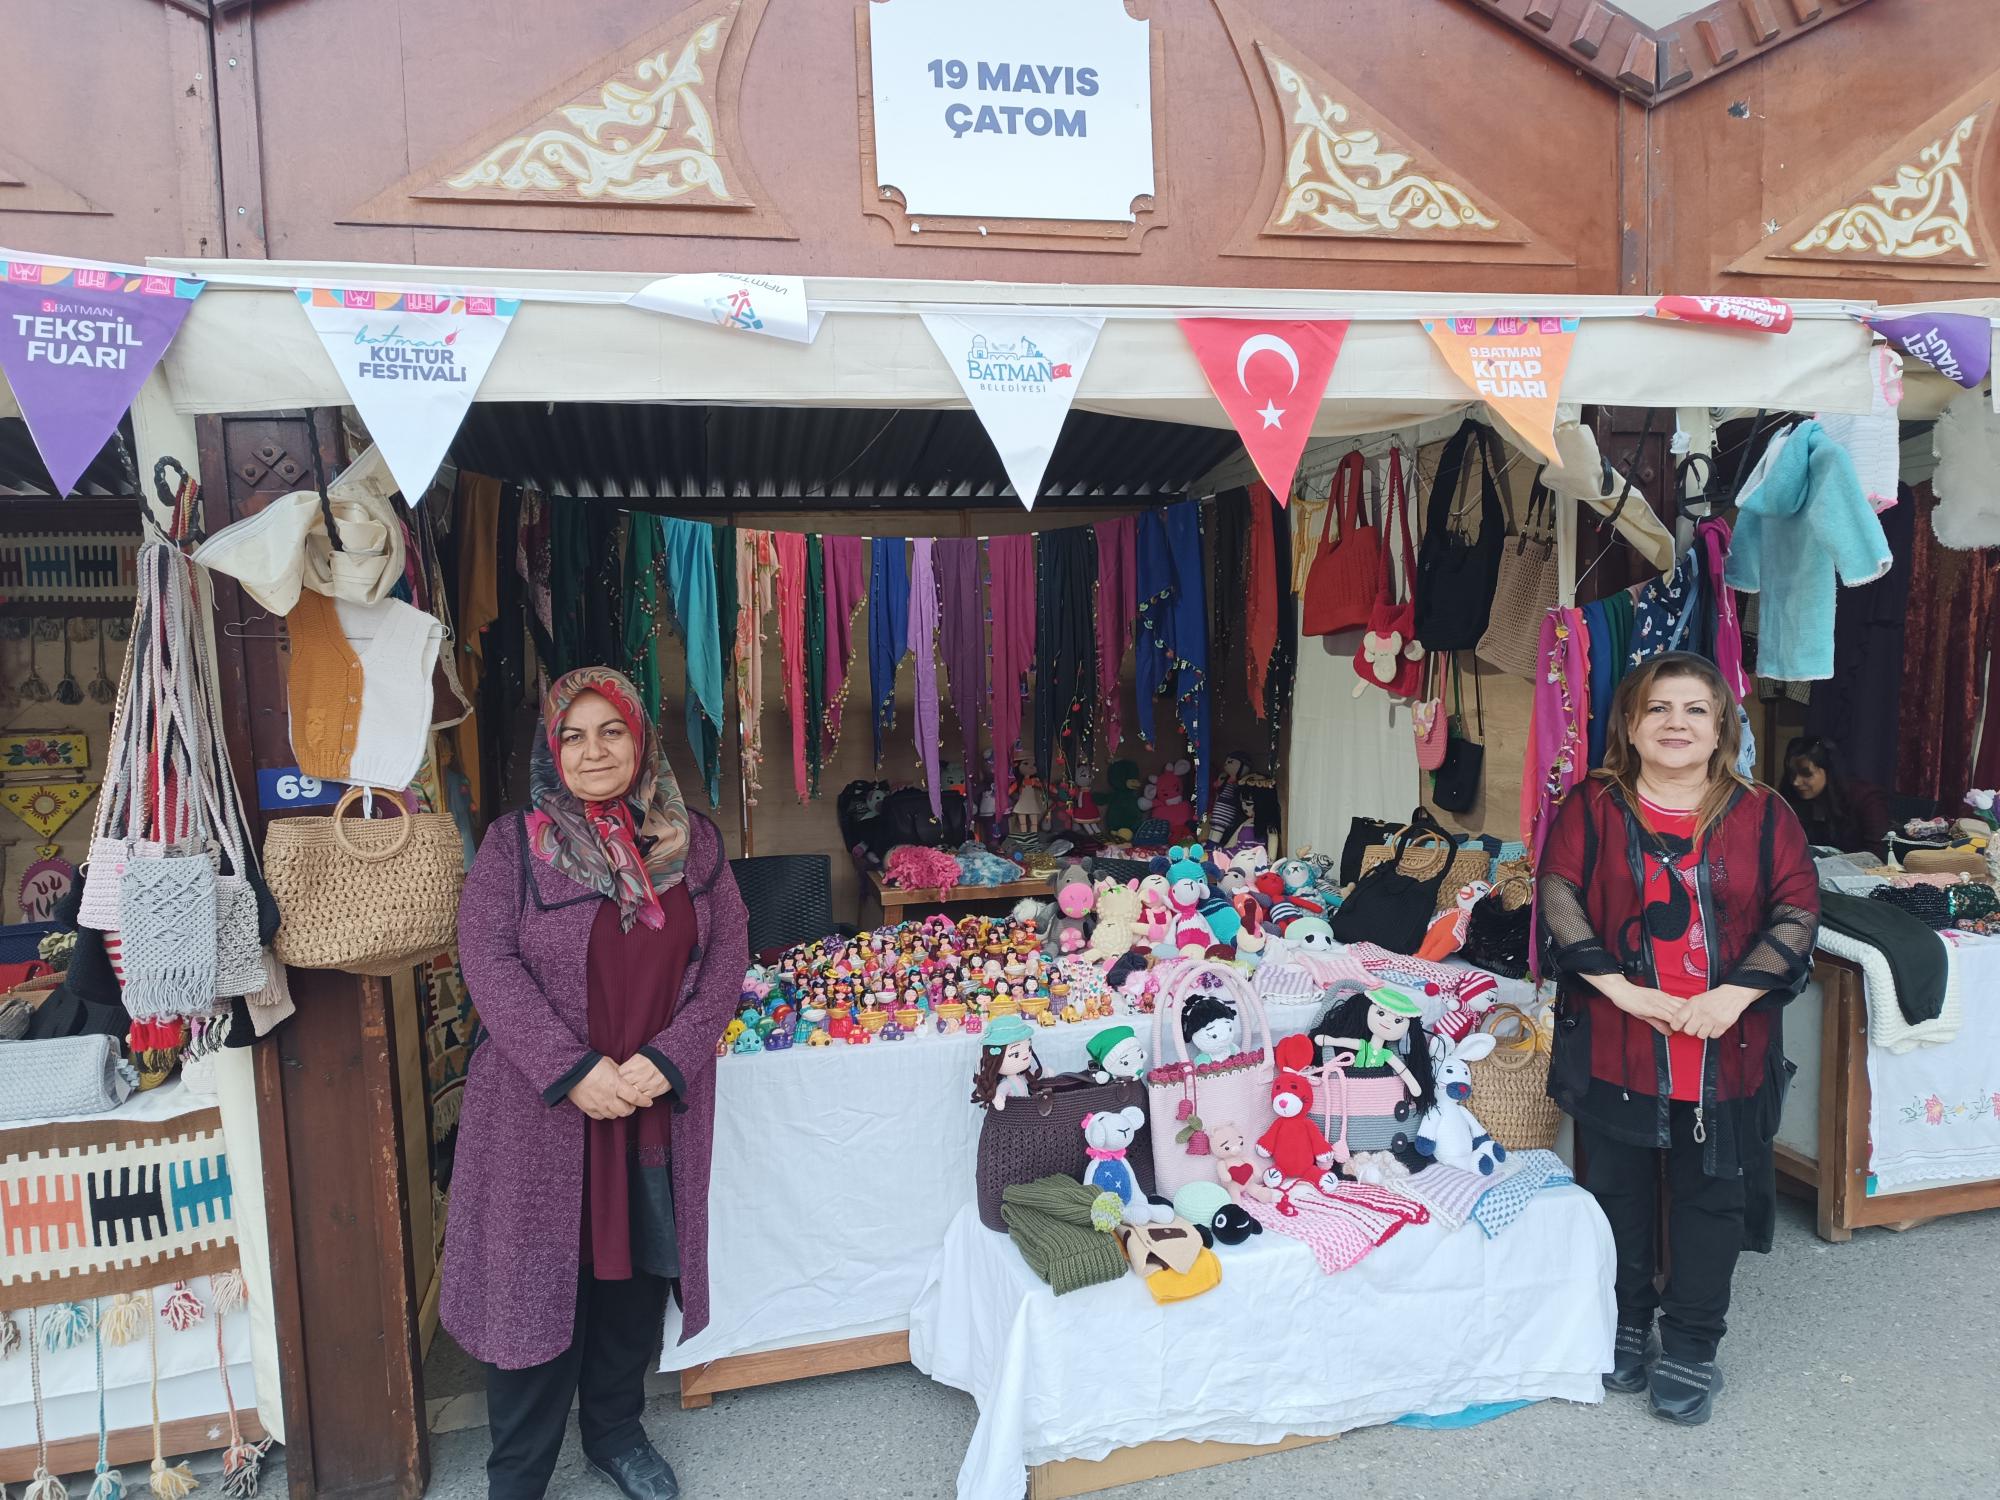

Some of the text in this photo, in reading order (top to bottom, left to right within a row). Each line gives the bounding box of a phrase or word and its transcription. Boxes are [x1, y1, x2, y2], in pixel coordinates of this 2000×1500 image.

[928, 58, 1099, 97] 19 MAYIS
[945, 102, 1087, 139] ÇATOM
[12, 314, 143, 347] TEKSTİL
[27, 340, 126, 370] FUARI
[370, 345, 455, 365] KÜLTÜR
[966, 359, 1054, 383] BATMAN
[1475, 380, 1549, 399] FUARI
[276, 774, 323, 800] 69
